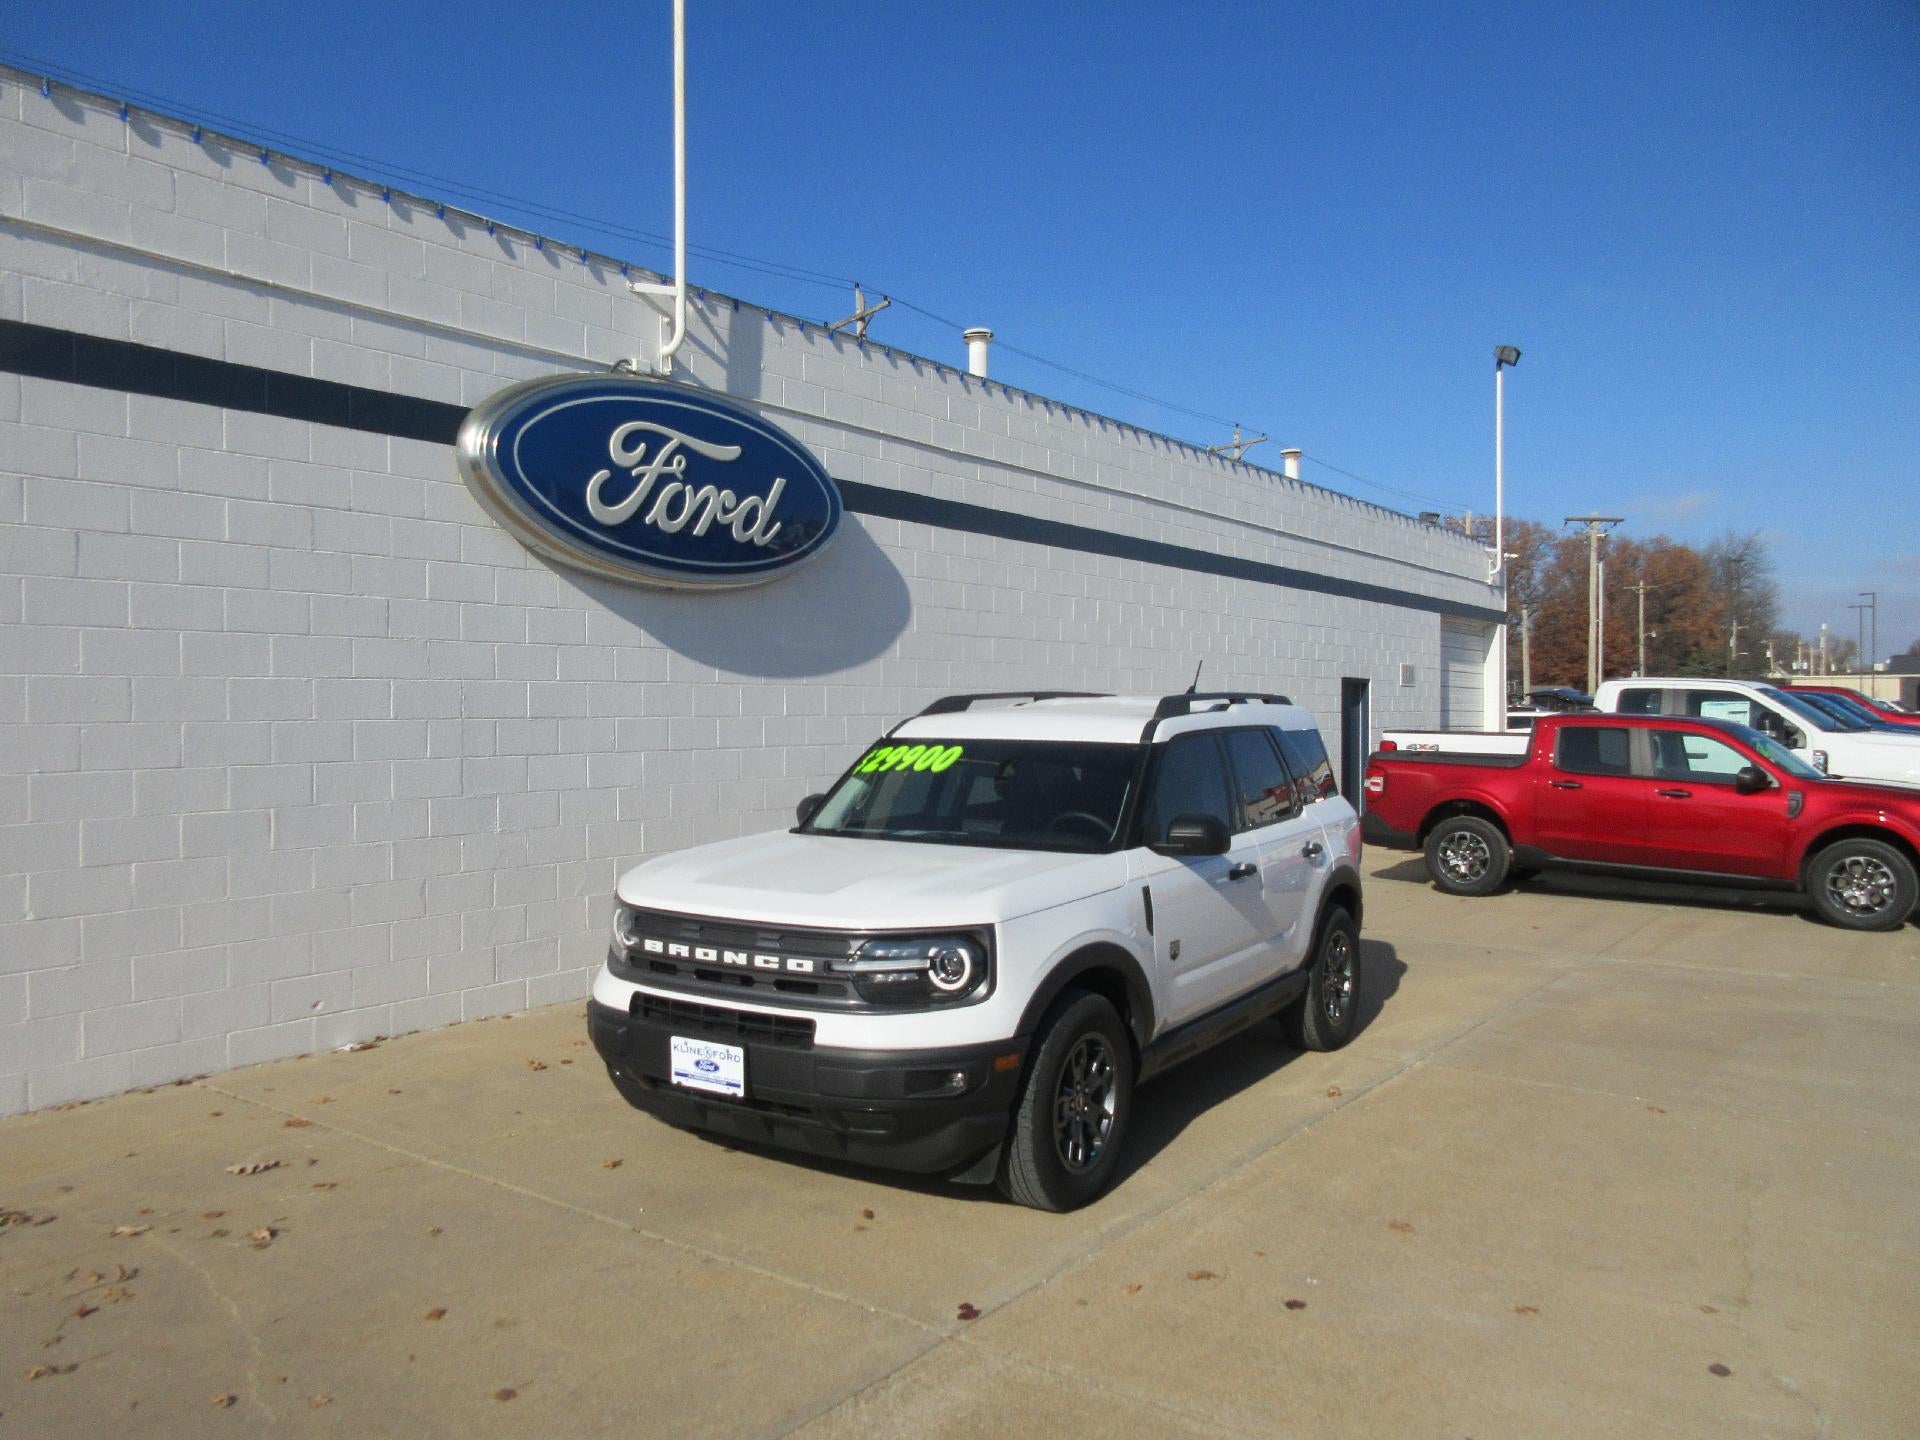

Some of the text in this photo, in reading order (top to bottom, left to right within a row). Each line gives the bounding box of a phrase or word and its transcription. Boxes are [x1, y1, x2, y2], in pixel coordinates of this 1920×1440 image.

[586, 421, 786, 546] Ford
[644, 939, 814, 972] BRONCO
[673, 1043, 703, 1056] KLINE
[712, 1050, 741, 1063] FORD
